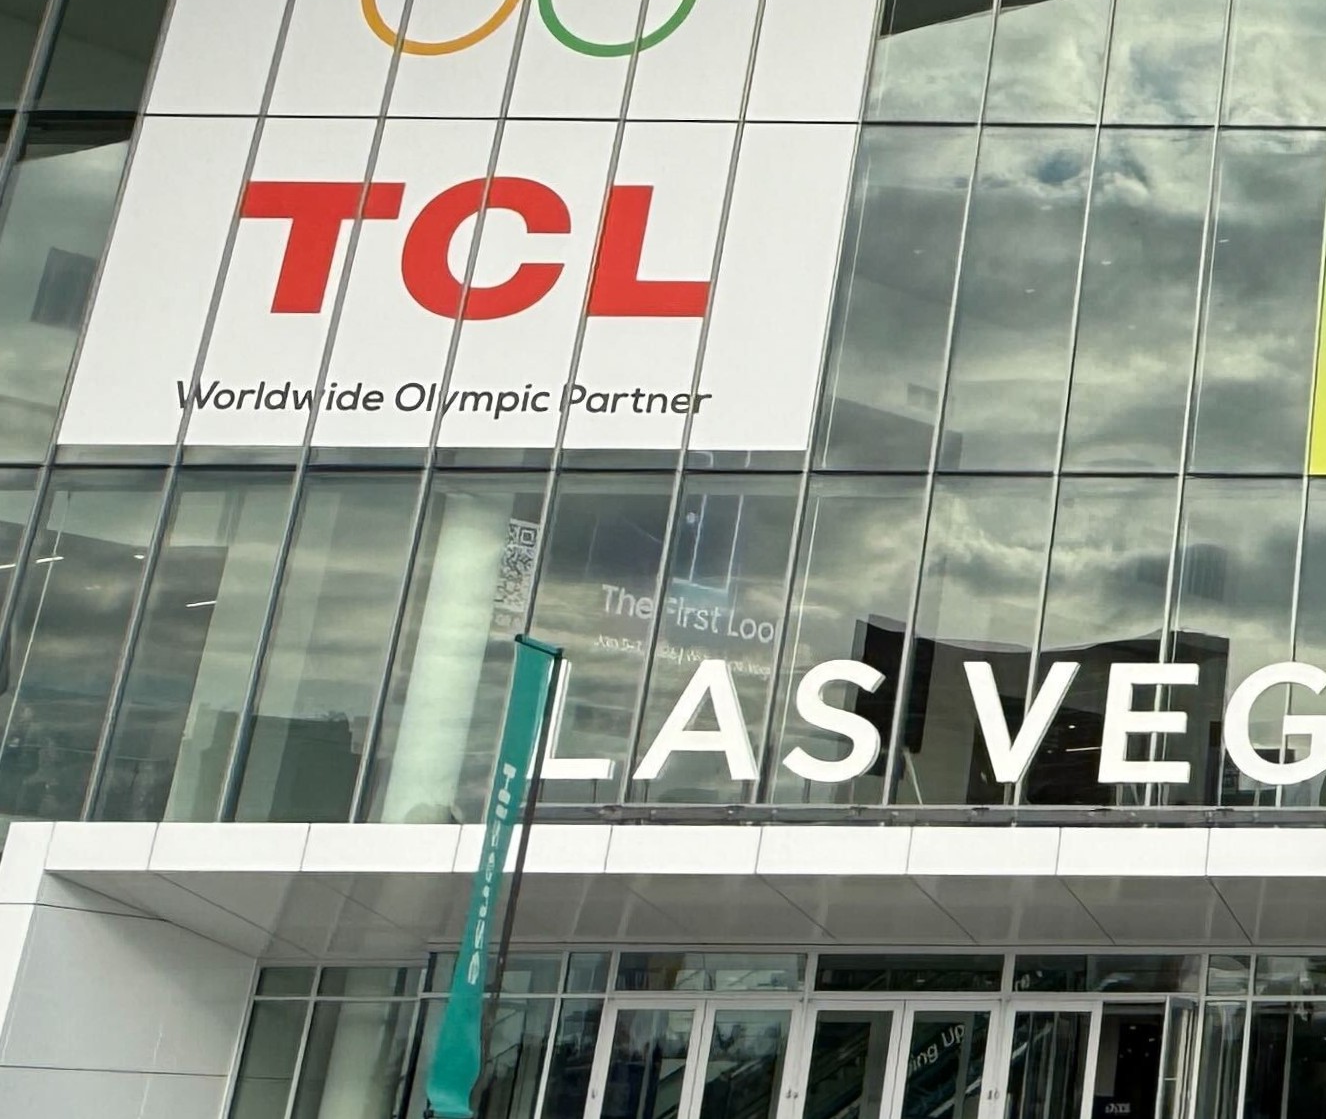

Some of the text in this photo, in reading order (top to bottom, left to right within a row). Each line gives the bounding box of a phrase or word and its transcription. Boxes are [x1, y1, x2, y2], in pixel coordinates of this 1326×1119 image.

[240, 176, 711, 321] TCL
[175, 378, 713, 422] Worldwide Olympic Partner
[601, 583, 654, 620] The
[727, 606, 783, 644] Loo
[526, 657, 887, 783] LAS
